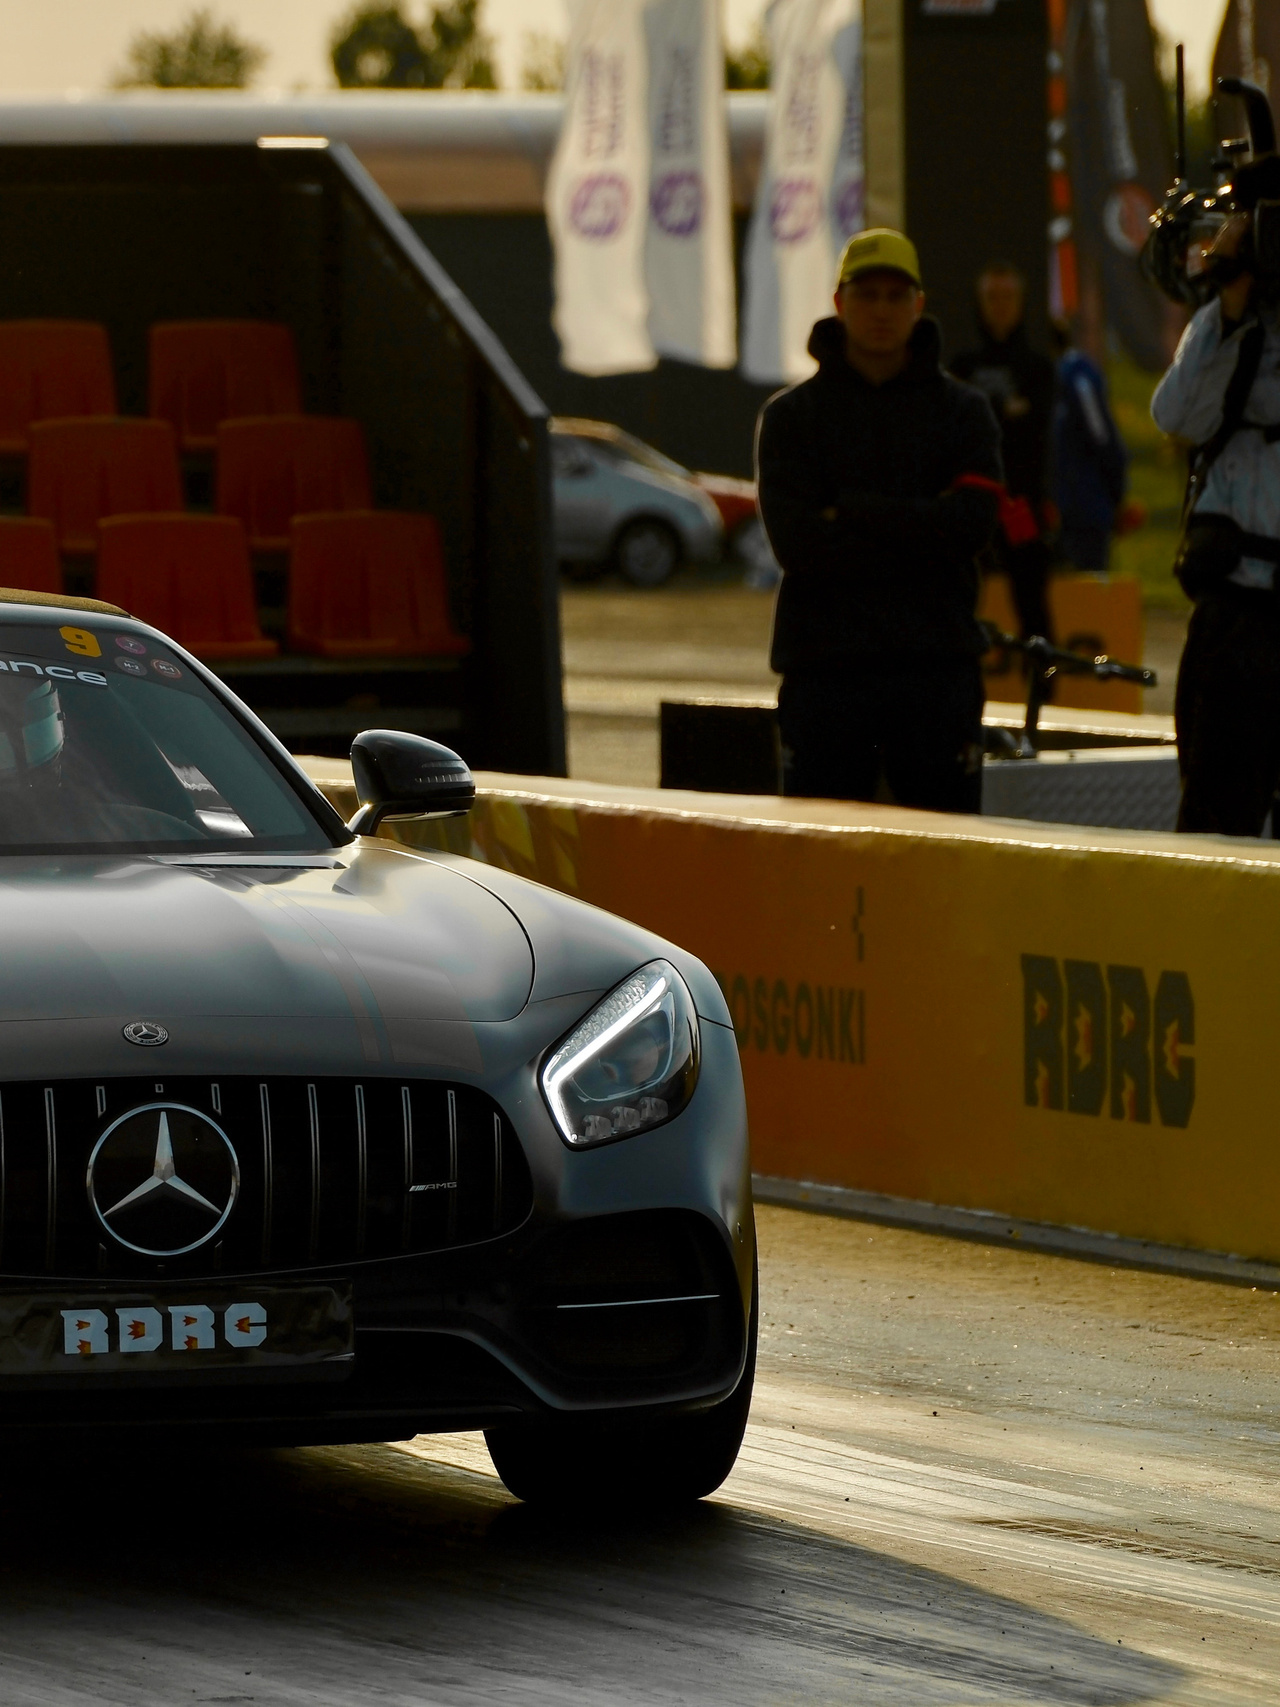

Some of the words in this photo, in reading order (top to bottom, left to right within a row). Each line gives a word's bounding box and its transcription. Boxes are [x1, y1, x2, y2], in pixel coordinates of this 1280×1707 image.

[58, 625, 102, 658] 9
[715, 971, 868, 1066] OSGONKI
[1021, 953, 1195, 1129] RDRC
[424, 1181, 458, 1191] AMG
[60, 1301, 268, 1355] RDRC
